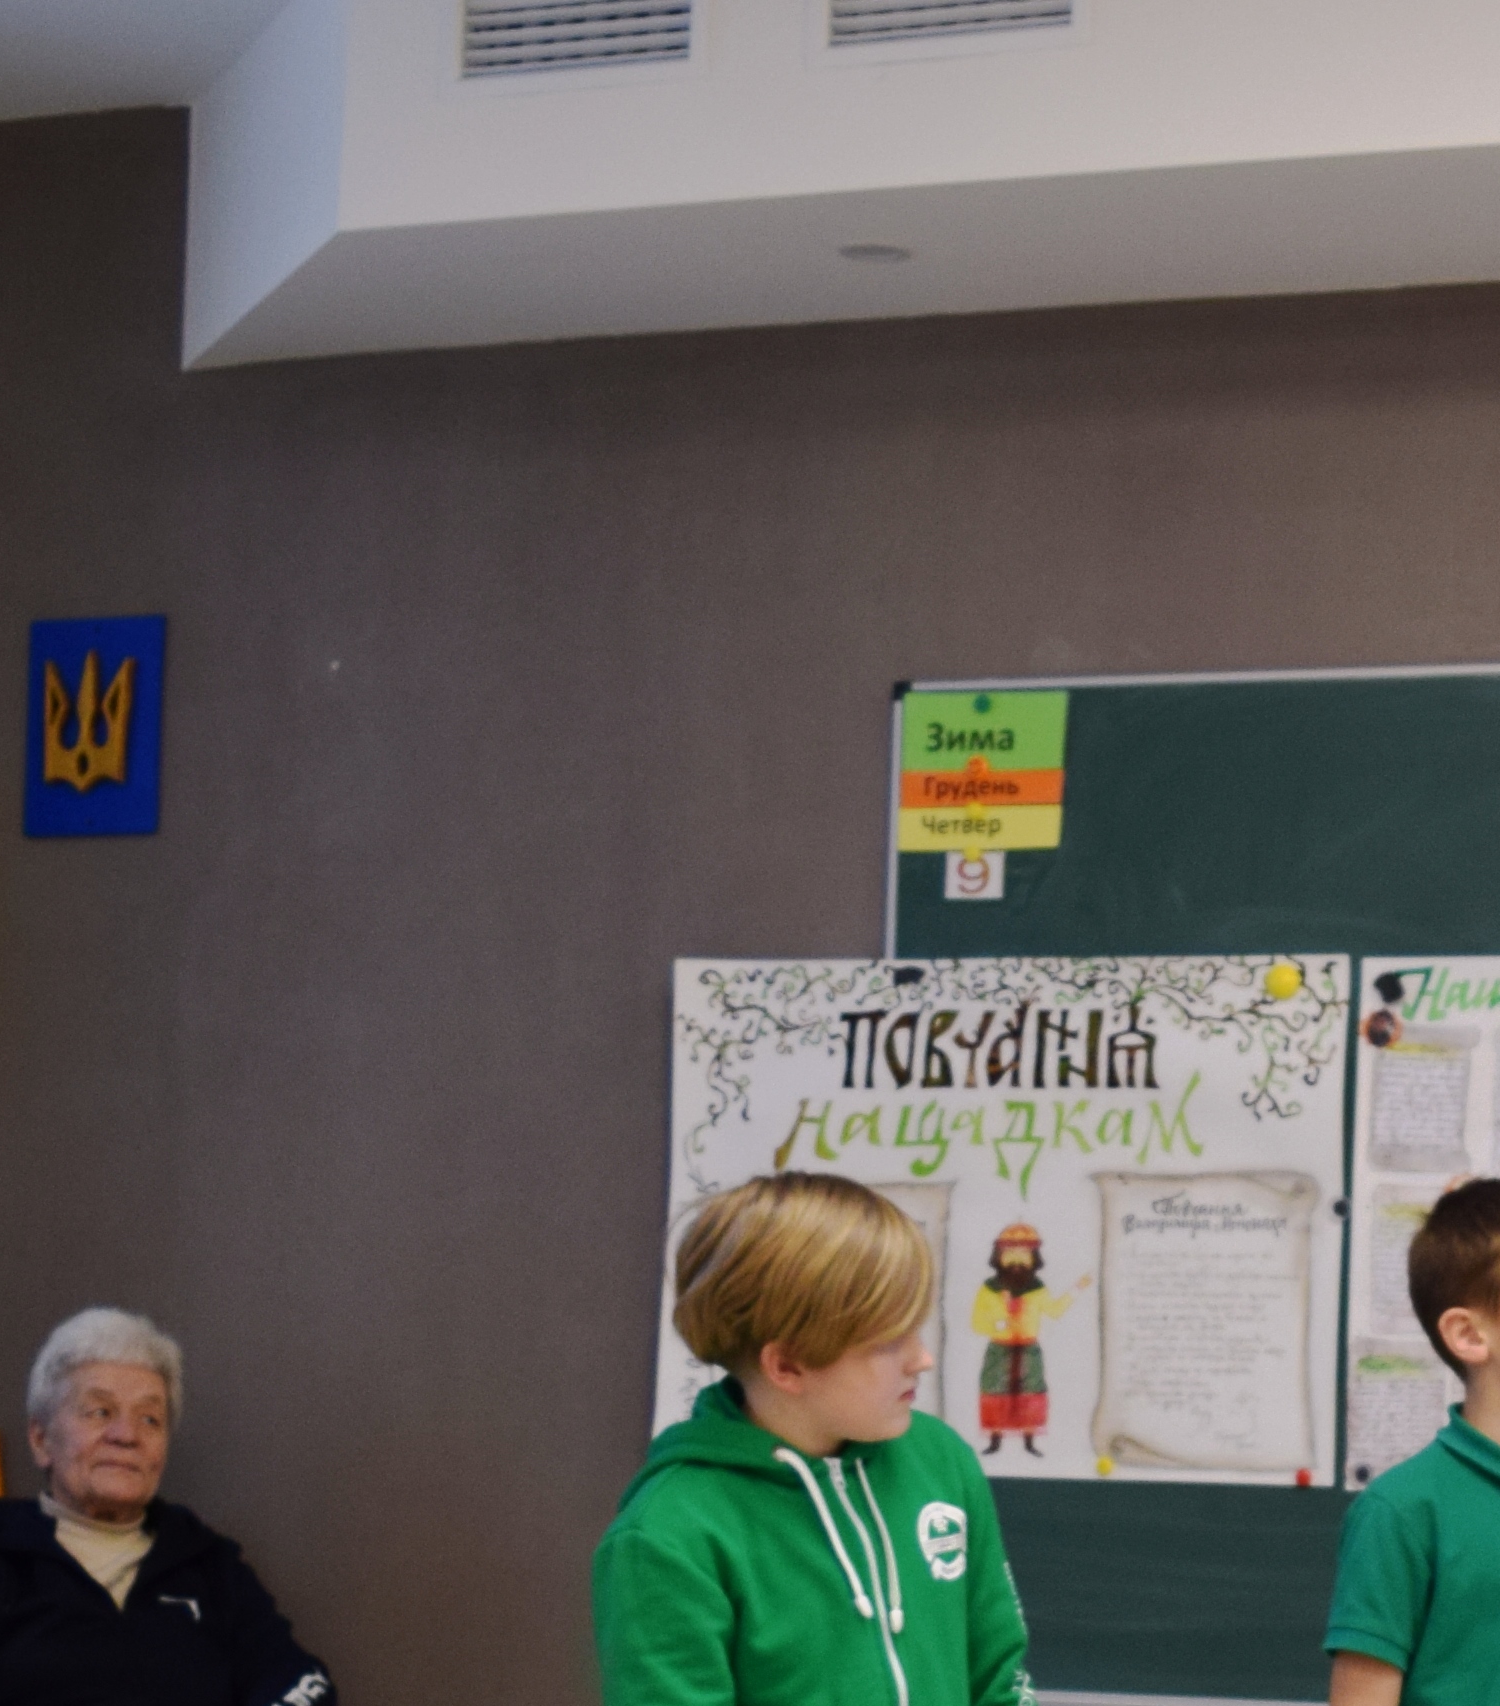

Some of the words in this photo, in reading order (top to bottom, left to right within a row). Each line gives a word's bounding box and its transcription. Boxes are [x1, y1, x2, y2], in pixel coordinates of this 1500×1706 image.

[926, 722, 1016, 752] Зима
[923, 776, 1020, 800] Грудень
[921, 815, 1002, 837] Четвер
[956, 856, 991, 895] 9
